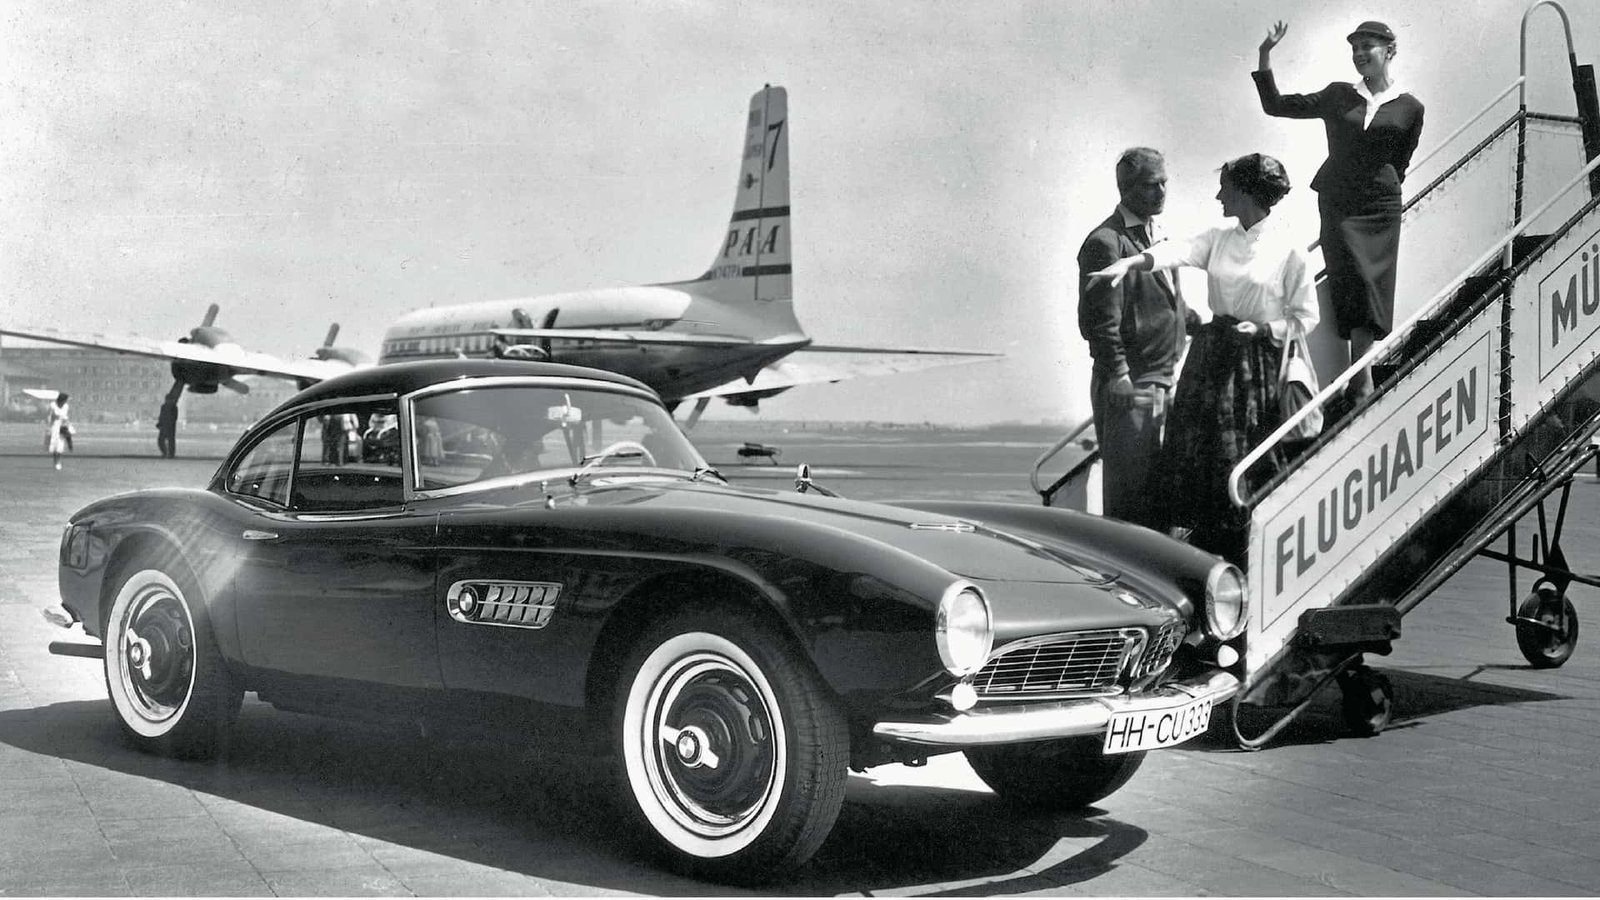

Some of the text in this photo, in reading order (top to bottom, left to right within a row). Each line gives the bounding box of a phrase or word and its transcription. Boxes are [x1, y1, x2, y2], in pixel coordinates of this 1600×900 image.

[768, 119, 785, 173] 7
[723, 225, 780, 258] PAA
[1552, 243, 1600, 348] MÜ
[1276, 366, 1476, 596] FLUGHAFEN
